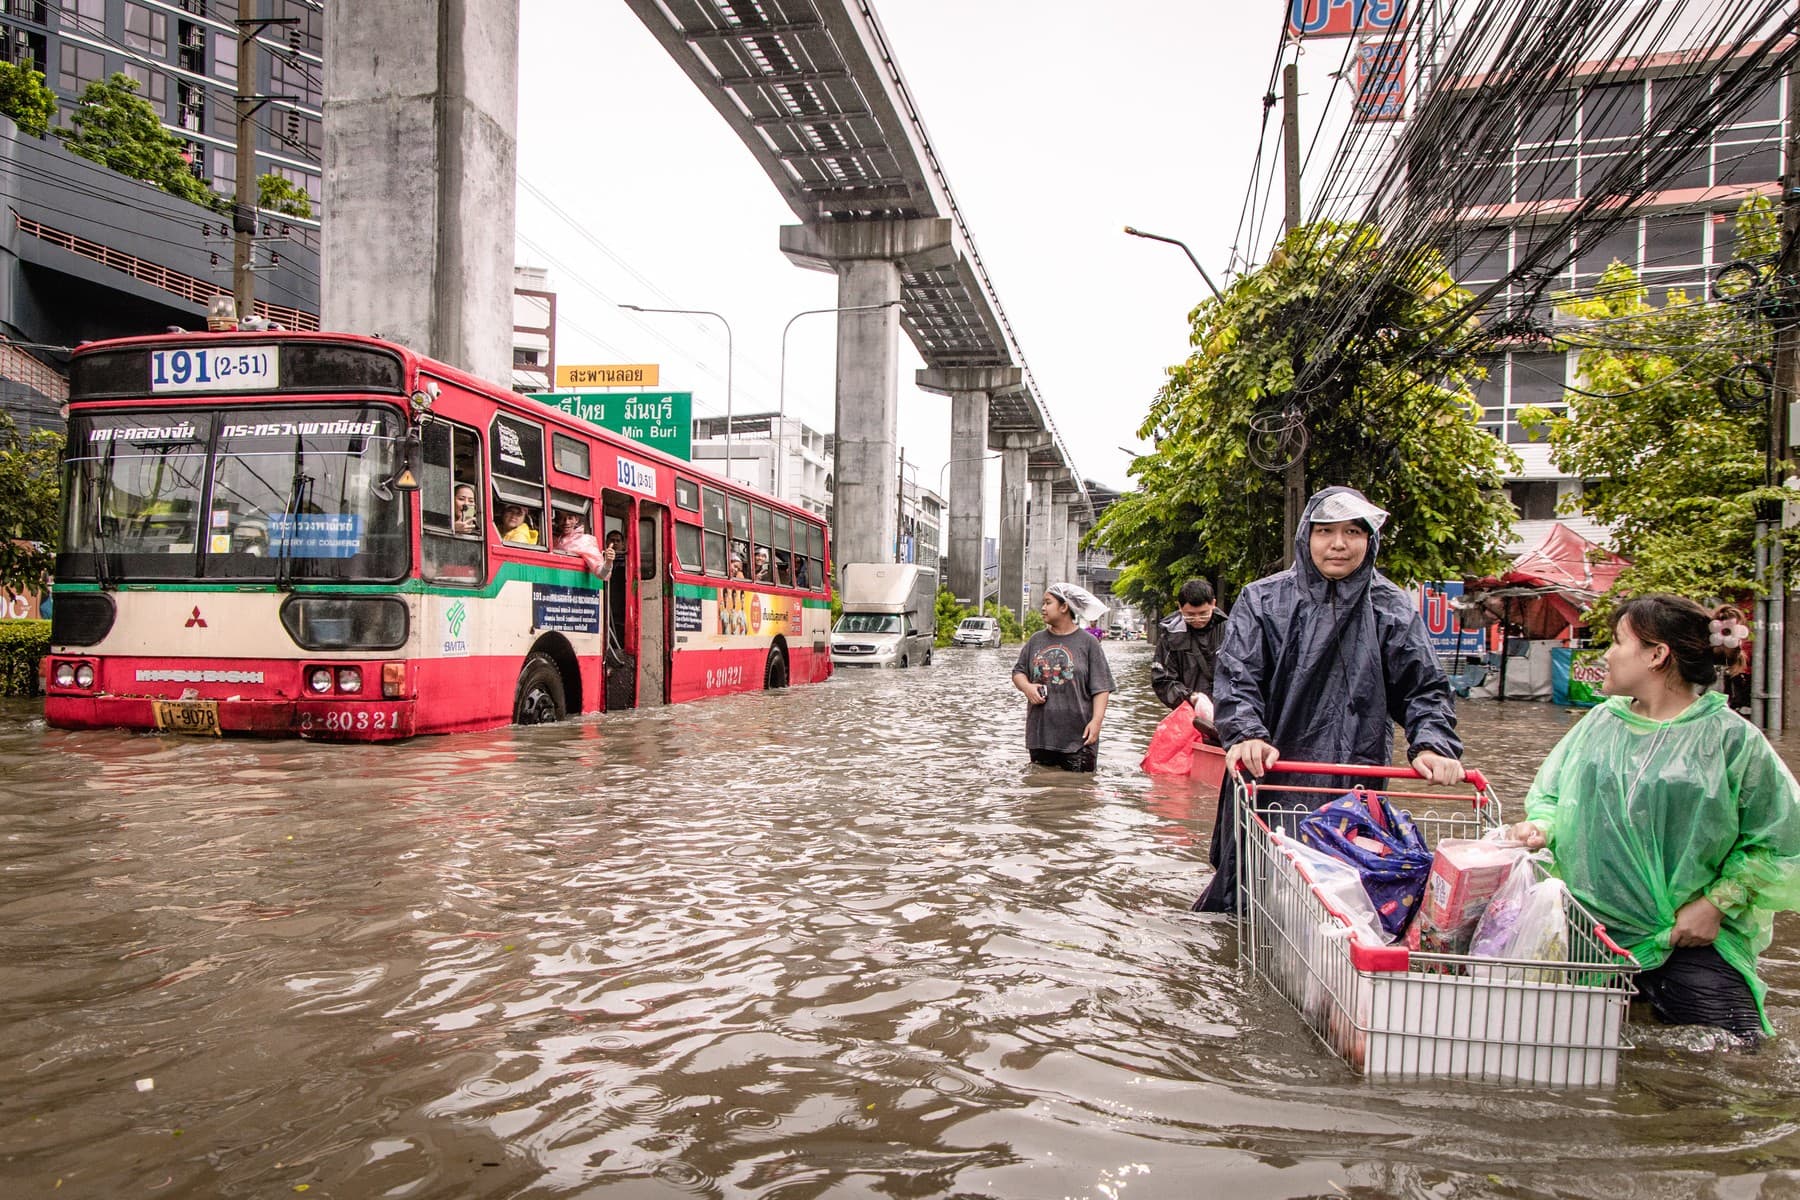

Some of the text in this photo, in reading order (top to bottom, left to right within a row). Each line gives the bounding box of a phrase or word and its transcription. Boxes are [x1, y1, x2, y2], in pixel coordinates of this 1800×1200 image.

[153, 350, 267, 384] 191 (2-51)
[570, 369, 643, 383] สะพานลอย
[624, 395, 673, 425] มีนบุรี
[222, 419, 381, 438] กระทรวงพาณิชย์
[622, 426, 677, 439] Min Buri
[618, 460, 654, 491] 191 (2-51)
[0, 594, 29, 619] C
[444, 641, 466, 652] BMTA
[706, 665, 742, 689] 8-80321
[301, 711, 400, 730] 8-80321
